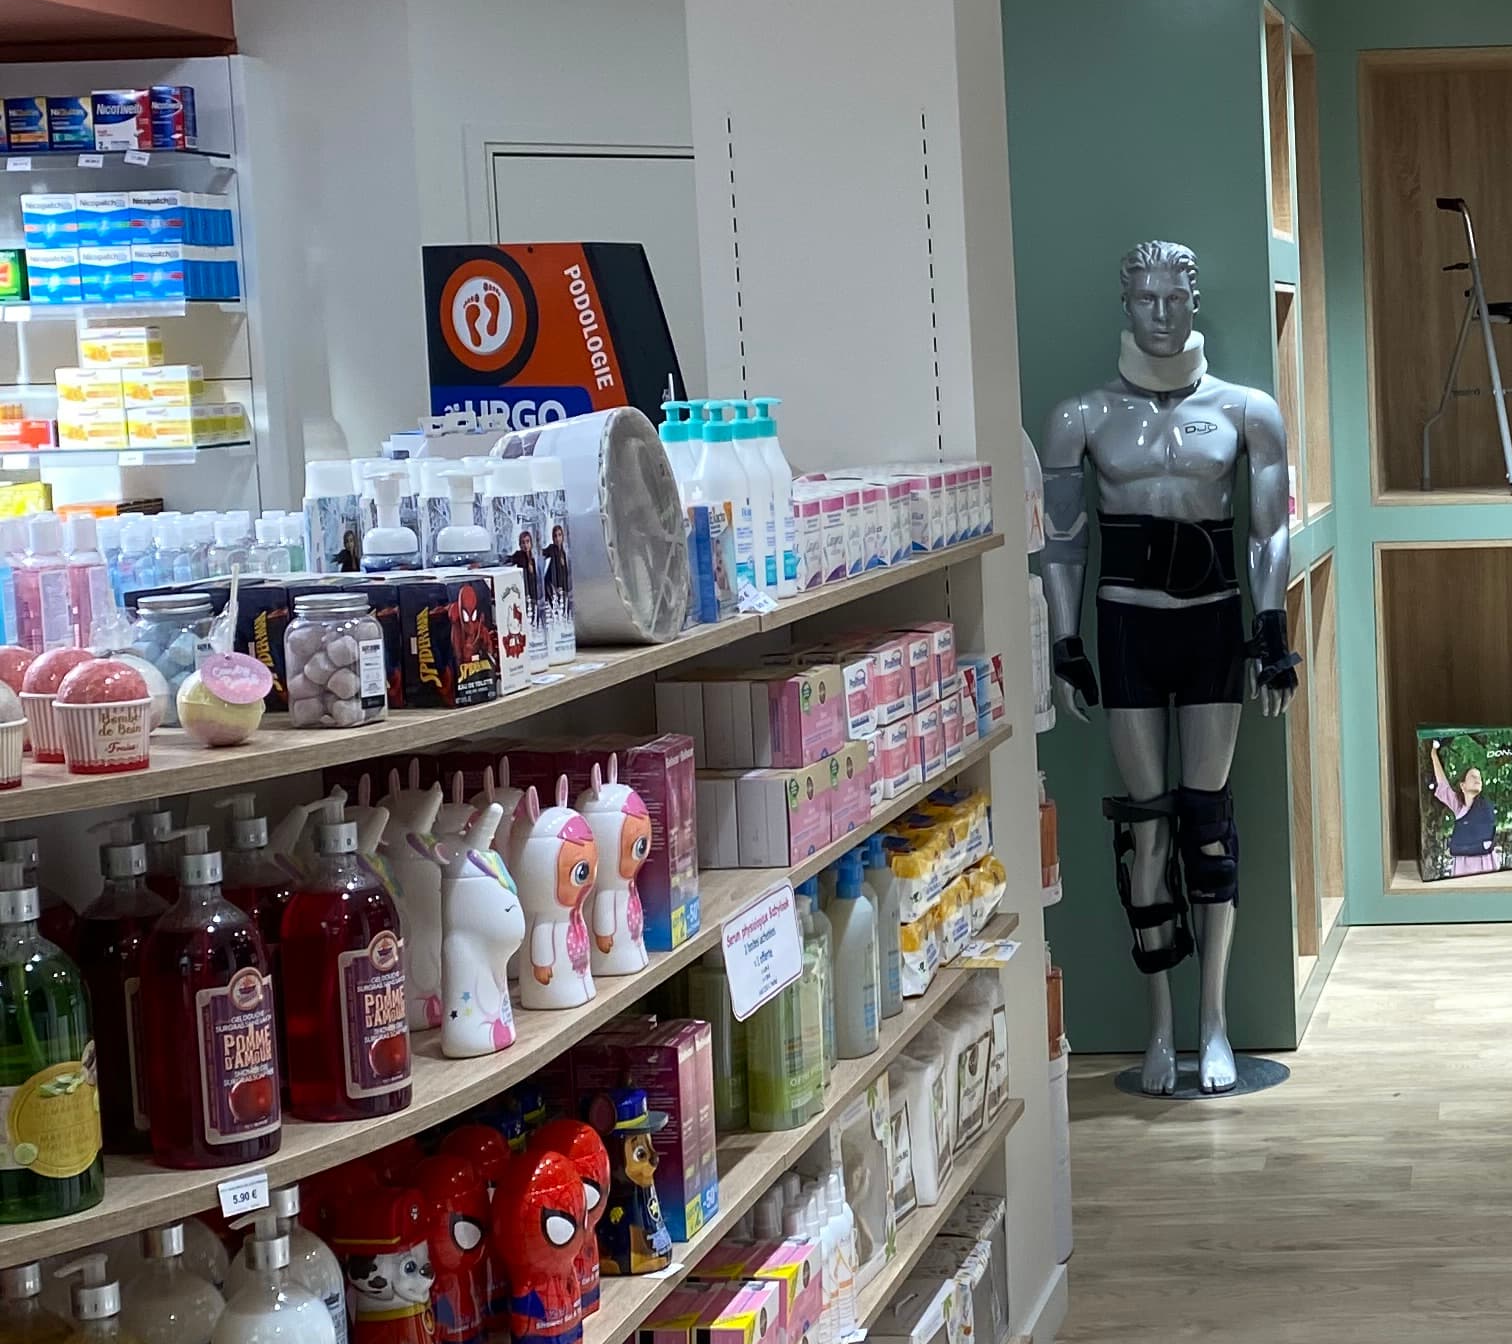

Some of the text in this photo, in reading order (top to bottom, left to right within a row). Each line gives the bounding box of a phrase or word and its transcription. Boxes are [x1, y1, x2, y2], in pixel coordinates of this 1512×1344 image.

[563, 264, 614, 391] PODOLOGIE
[364, 986, 405, 1014] POMME
[365, 1005, 406, 1029] D'AMOUR
[223, 1025, 272, 1056] POMME
[224, 1043, 272, 1071] D'AMOUR
[233, 1189, 257, 1205] 5.90 €
